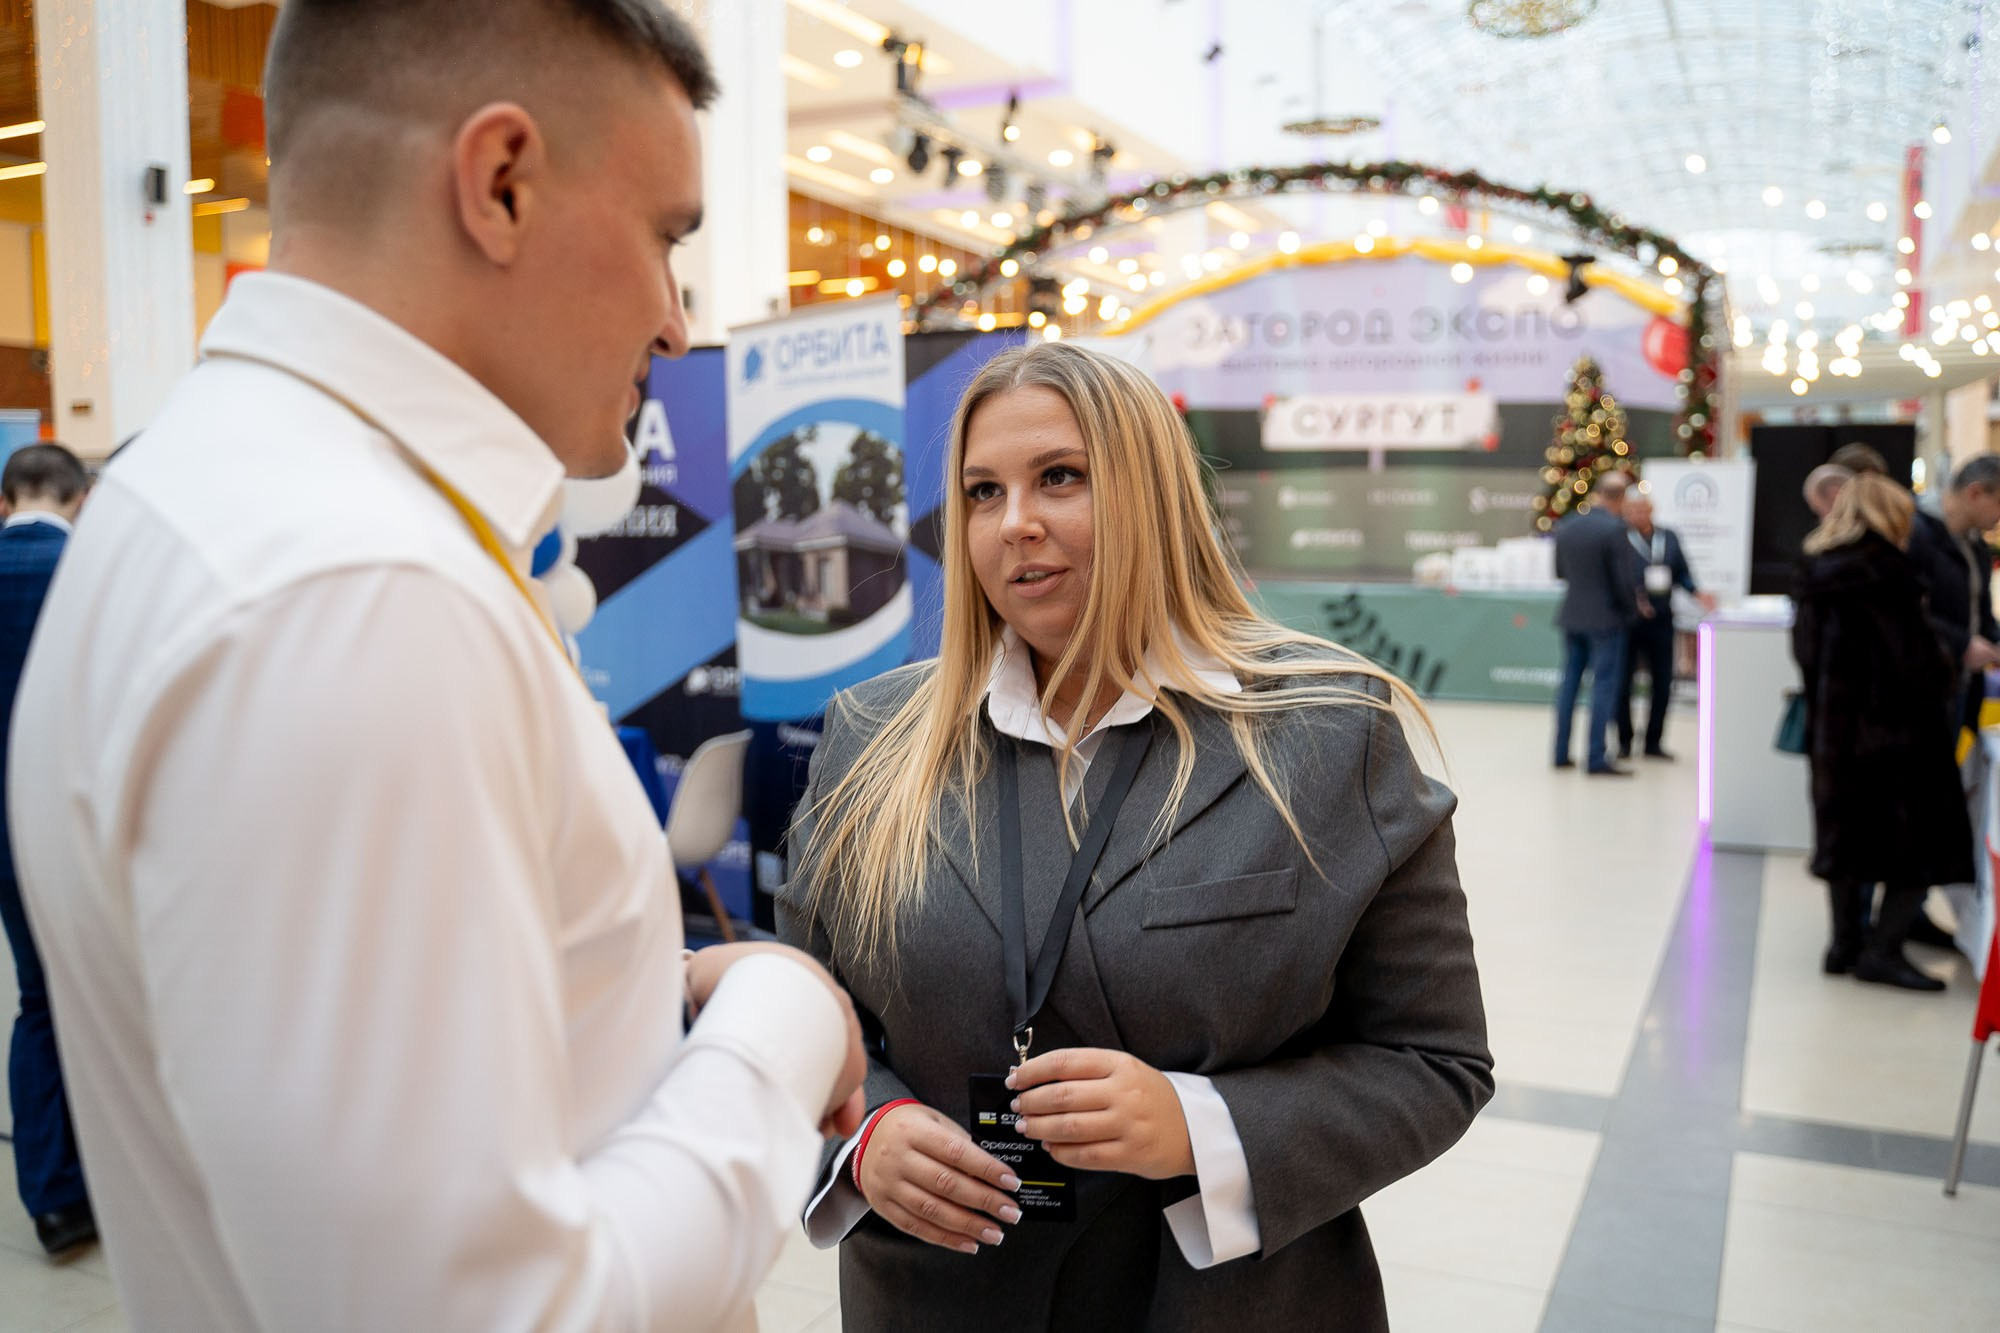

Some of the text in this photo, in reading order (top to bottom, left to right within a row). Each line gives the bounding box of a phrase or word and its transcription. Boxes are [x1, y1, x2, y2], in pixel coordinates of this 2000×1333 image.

[775, 322, 890, 371] ОРБИТА
[1187, 304, 1588, 350] ЗАГОРОД ЭКСПО
[1291, 401, 1461, 437] СУРГУТ
